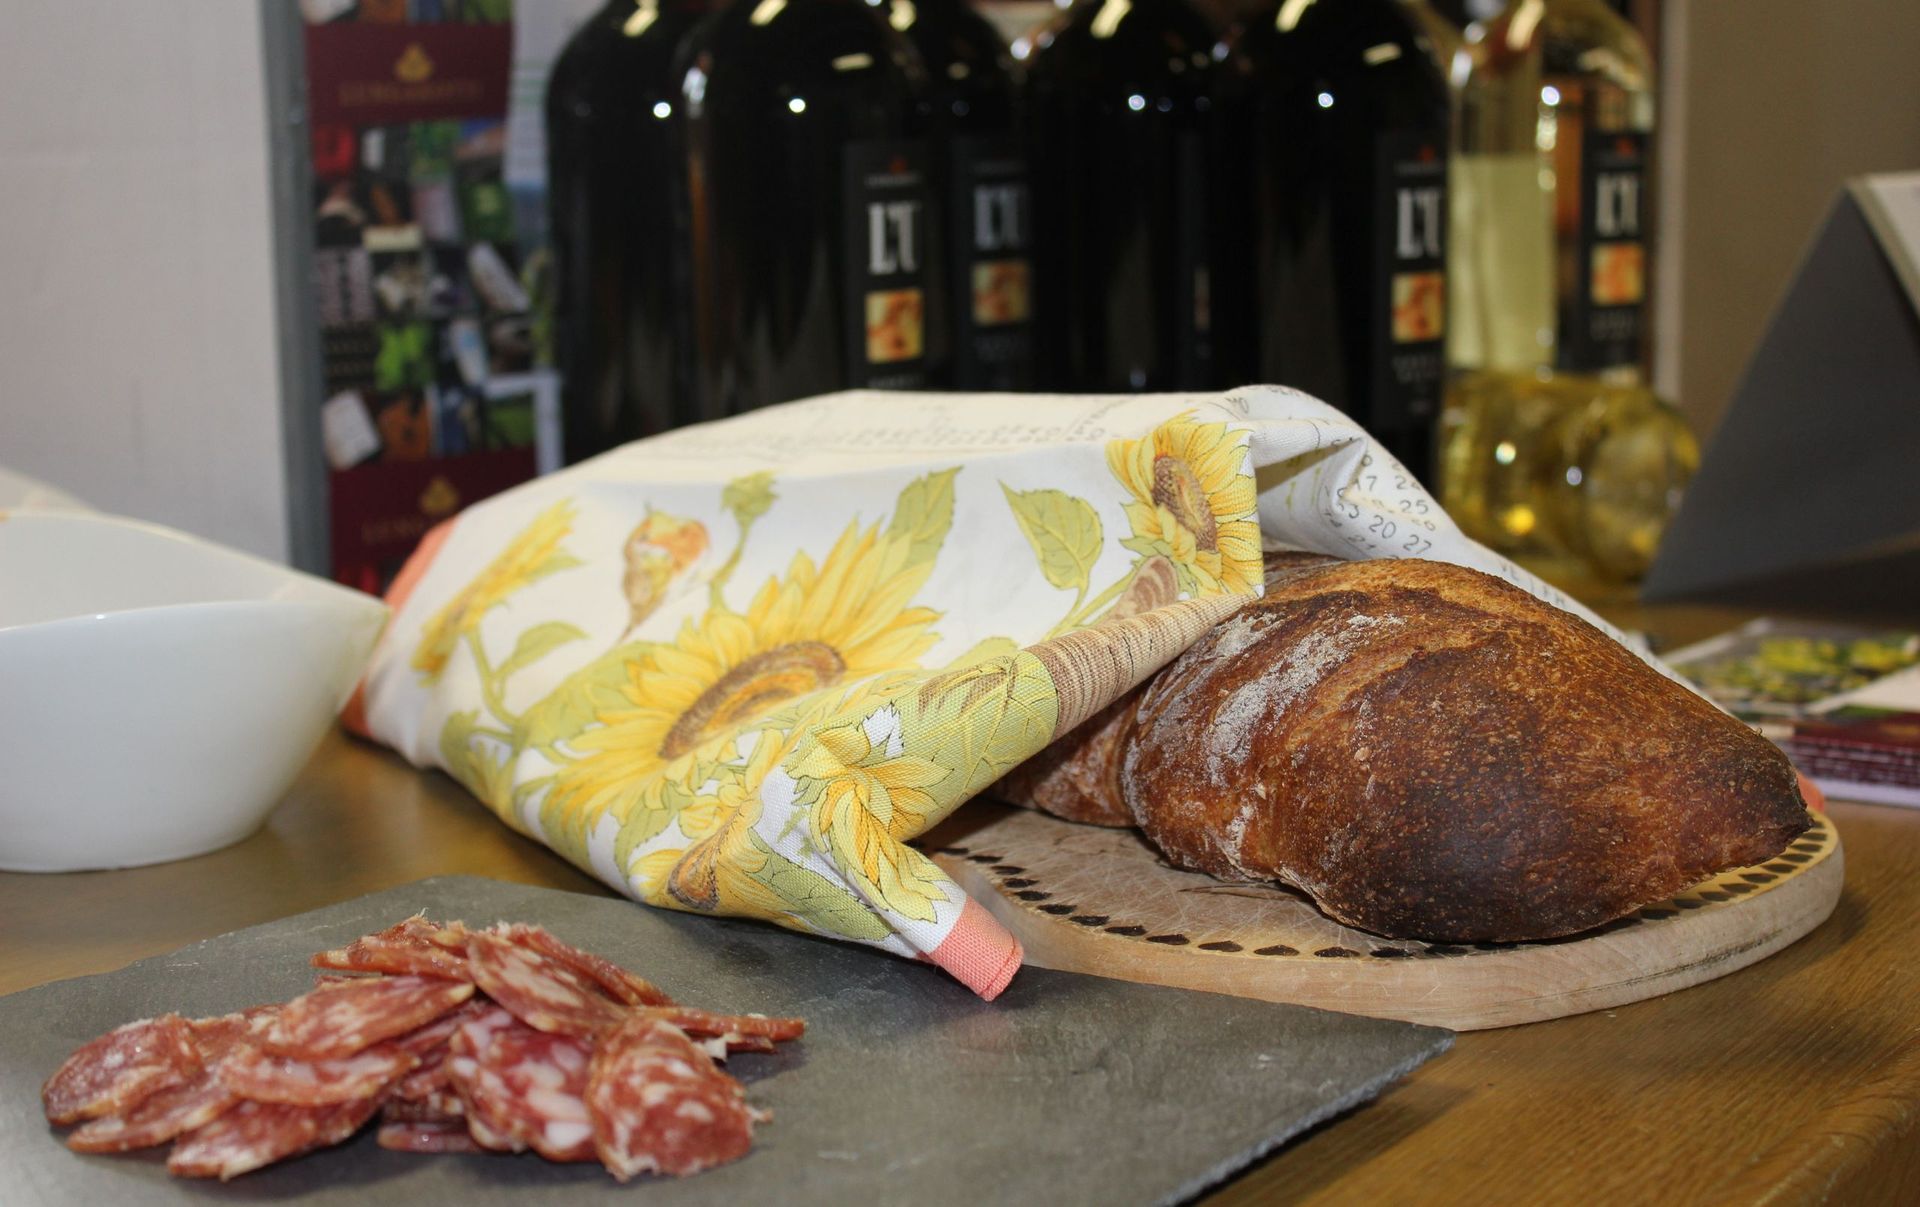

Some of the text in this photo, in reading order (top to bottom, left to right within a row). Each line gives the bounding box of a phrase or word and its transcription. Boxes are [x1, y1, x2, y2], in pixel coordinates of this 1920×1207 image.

[869, 201, 921, 275] LT
[1397, 187, 1440, 259] LT
[1368, 514, 1397, 539] 20
[1403, 534, 1432, 555] 27
[1399, 499, 1430, 515] 25
